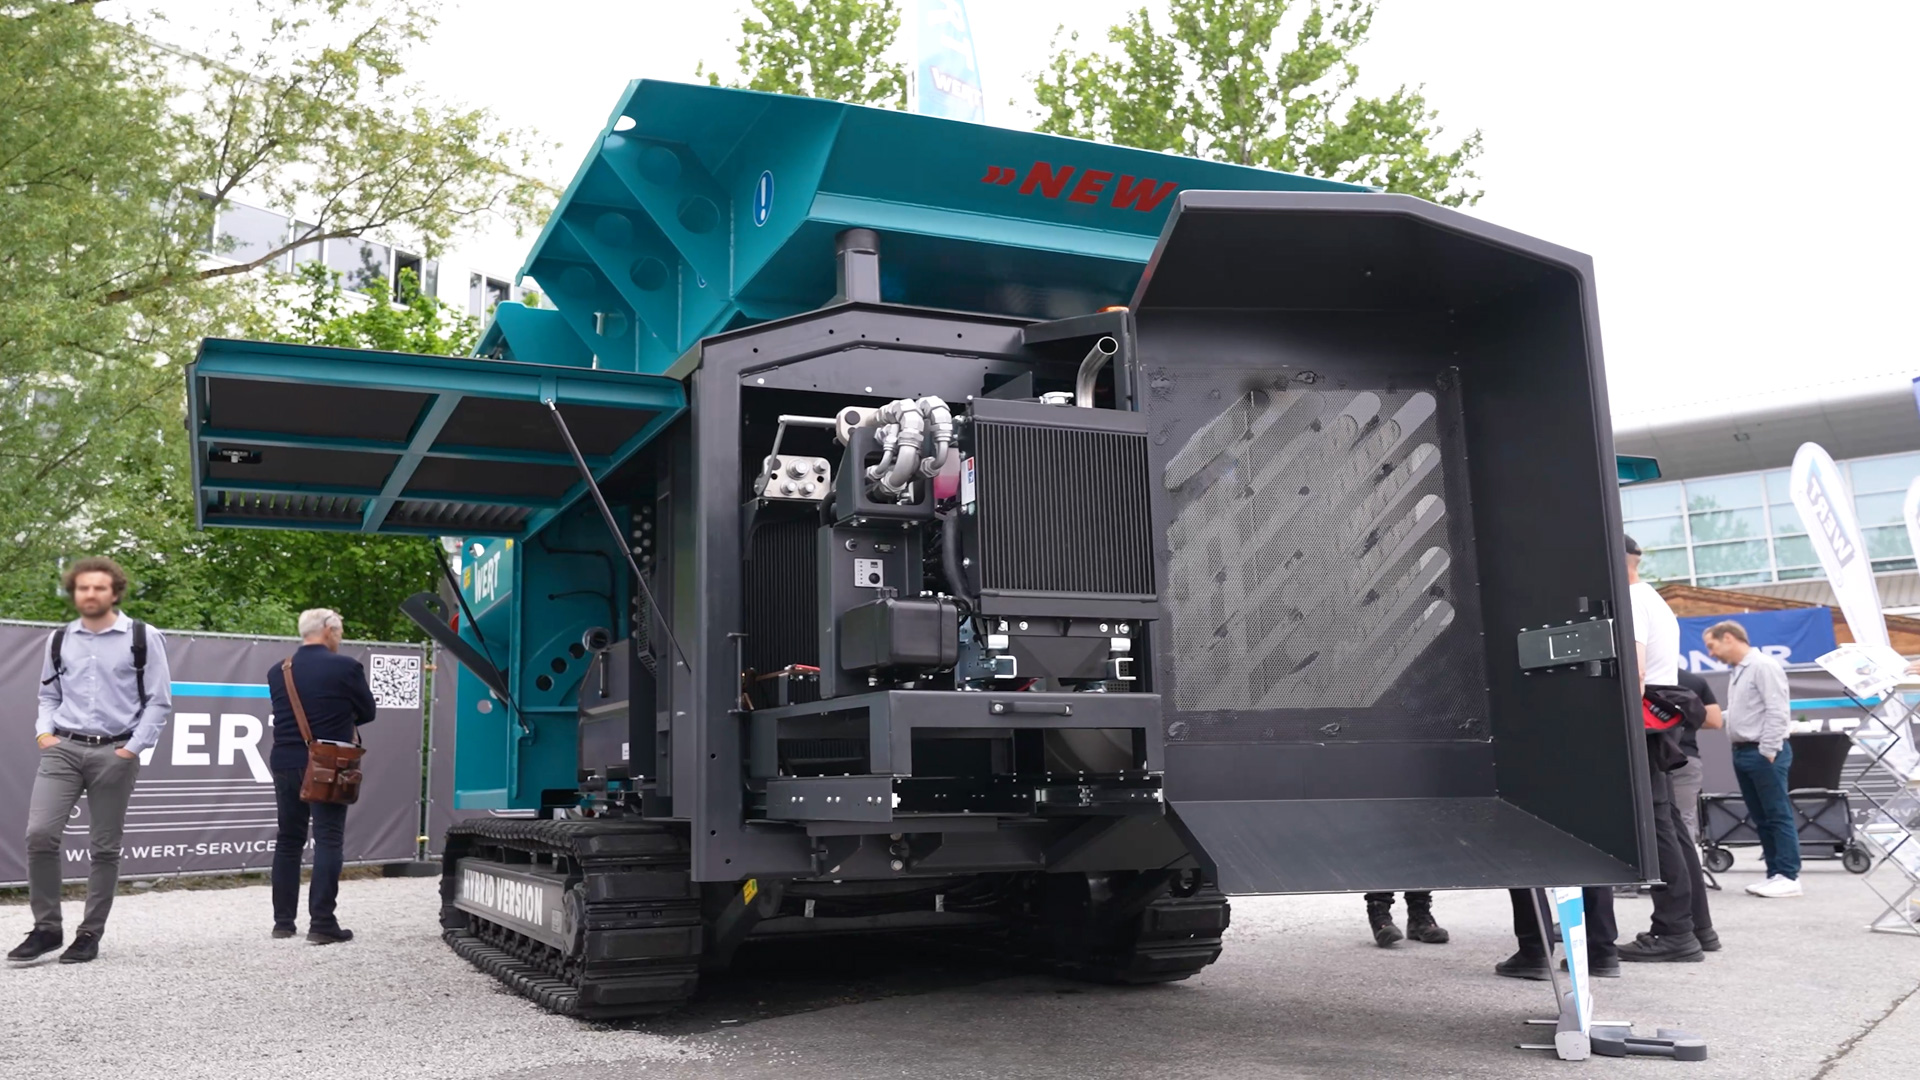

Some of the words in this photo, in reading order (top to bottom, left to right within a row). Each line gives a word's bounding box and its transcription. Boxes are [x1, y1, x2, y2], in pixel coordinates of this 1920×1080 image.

[474, 551, 501, 604] WERT
[139, 712, 276, 784] ER
[464, 869, 495, 907] HYBRID
[497, 877, 543, 926] VERSION
